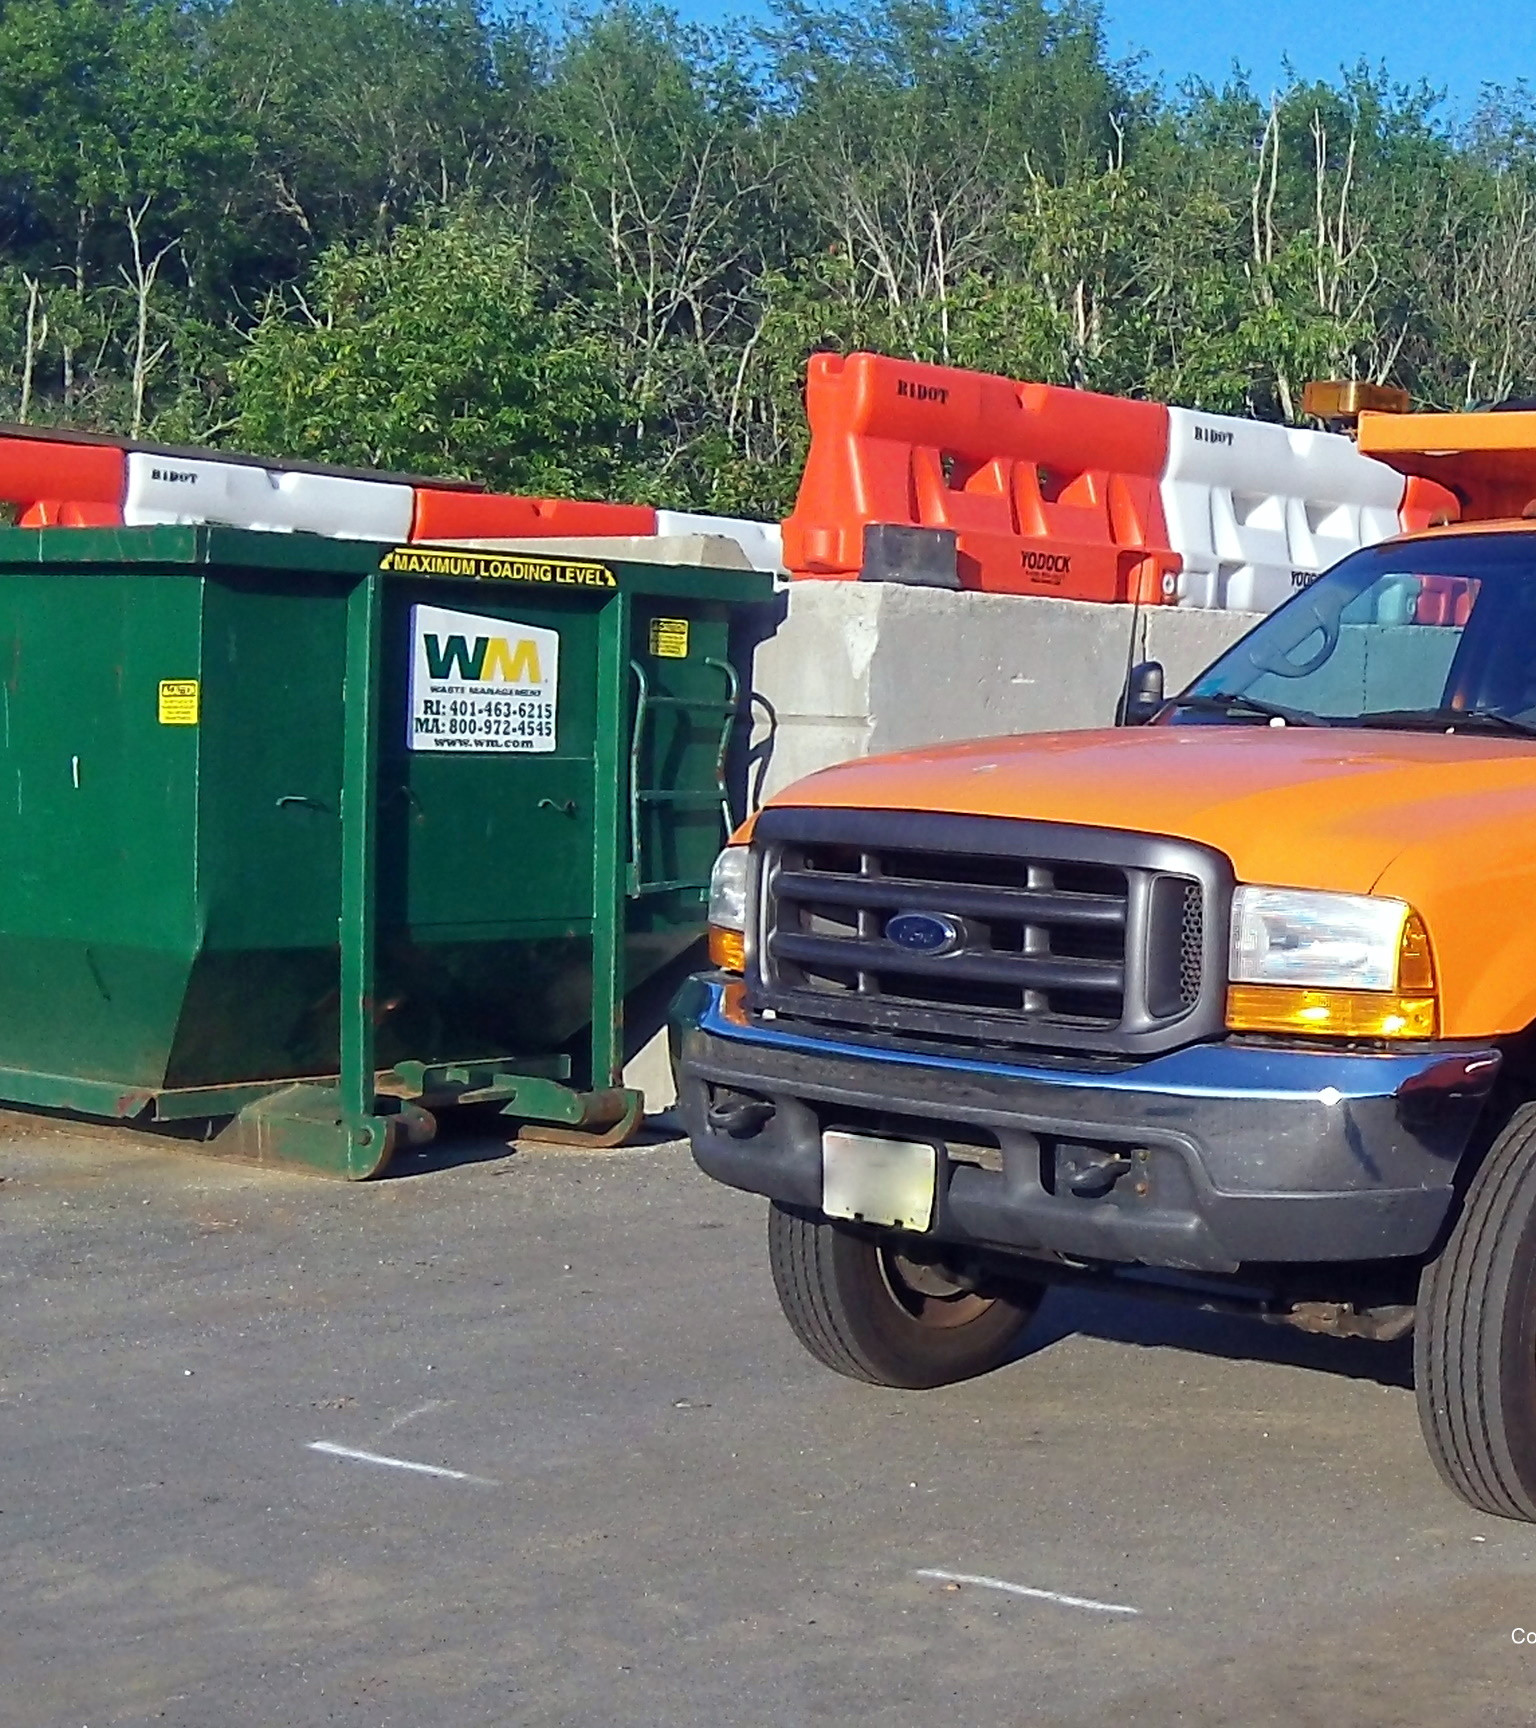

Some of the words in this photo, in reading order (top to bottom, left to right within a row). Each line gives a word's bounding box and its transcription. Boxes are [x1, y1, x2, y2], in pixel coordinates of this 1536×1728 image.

[898, 379, 949, 405] RIDOT
[1194, 426, 1234, 446] RIDOT
[394, 554, 475, 575] MAXIMUM
[480, 560, 551, 582] LOADING
[556, 567, 605, 586] LEVEL
[1021, 550, 1071, 573] YODOCK
[423, 634, 541, 683] WM
[423, 700, 446, 716] RI:
[450, 700, 552, 719] 401-463-6215
[415, 717, 446, 734] MA:
[450, 718, 552, 736] 800-972-4545
[434, 738, 534, 748] www.wm.com
